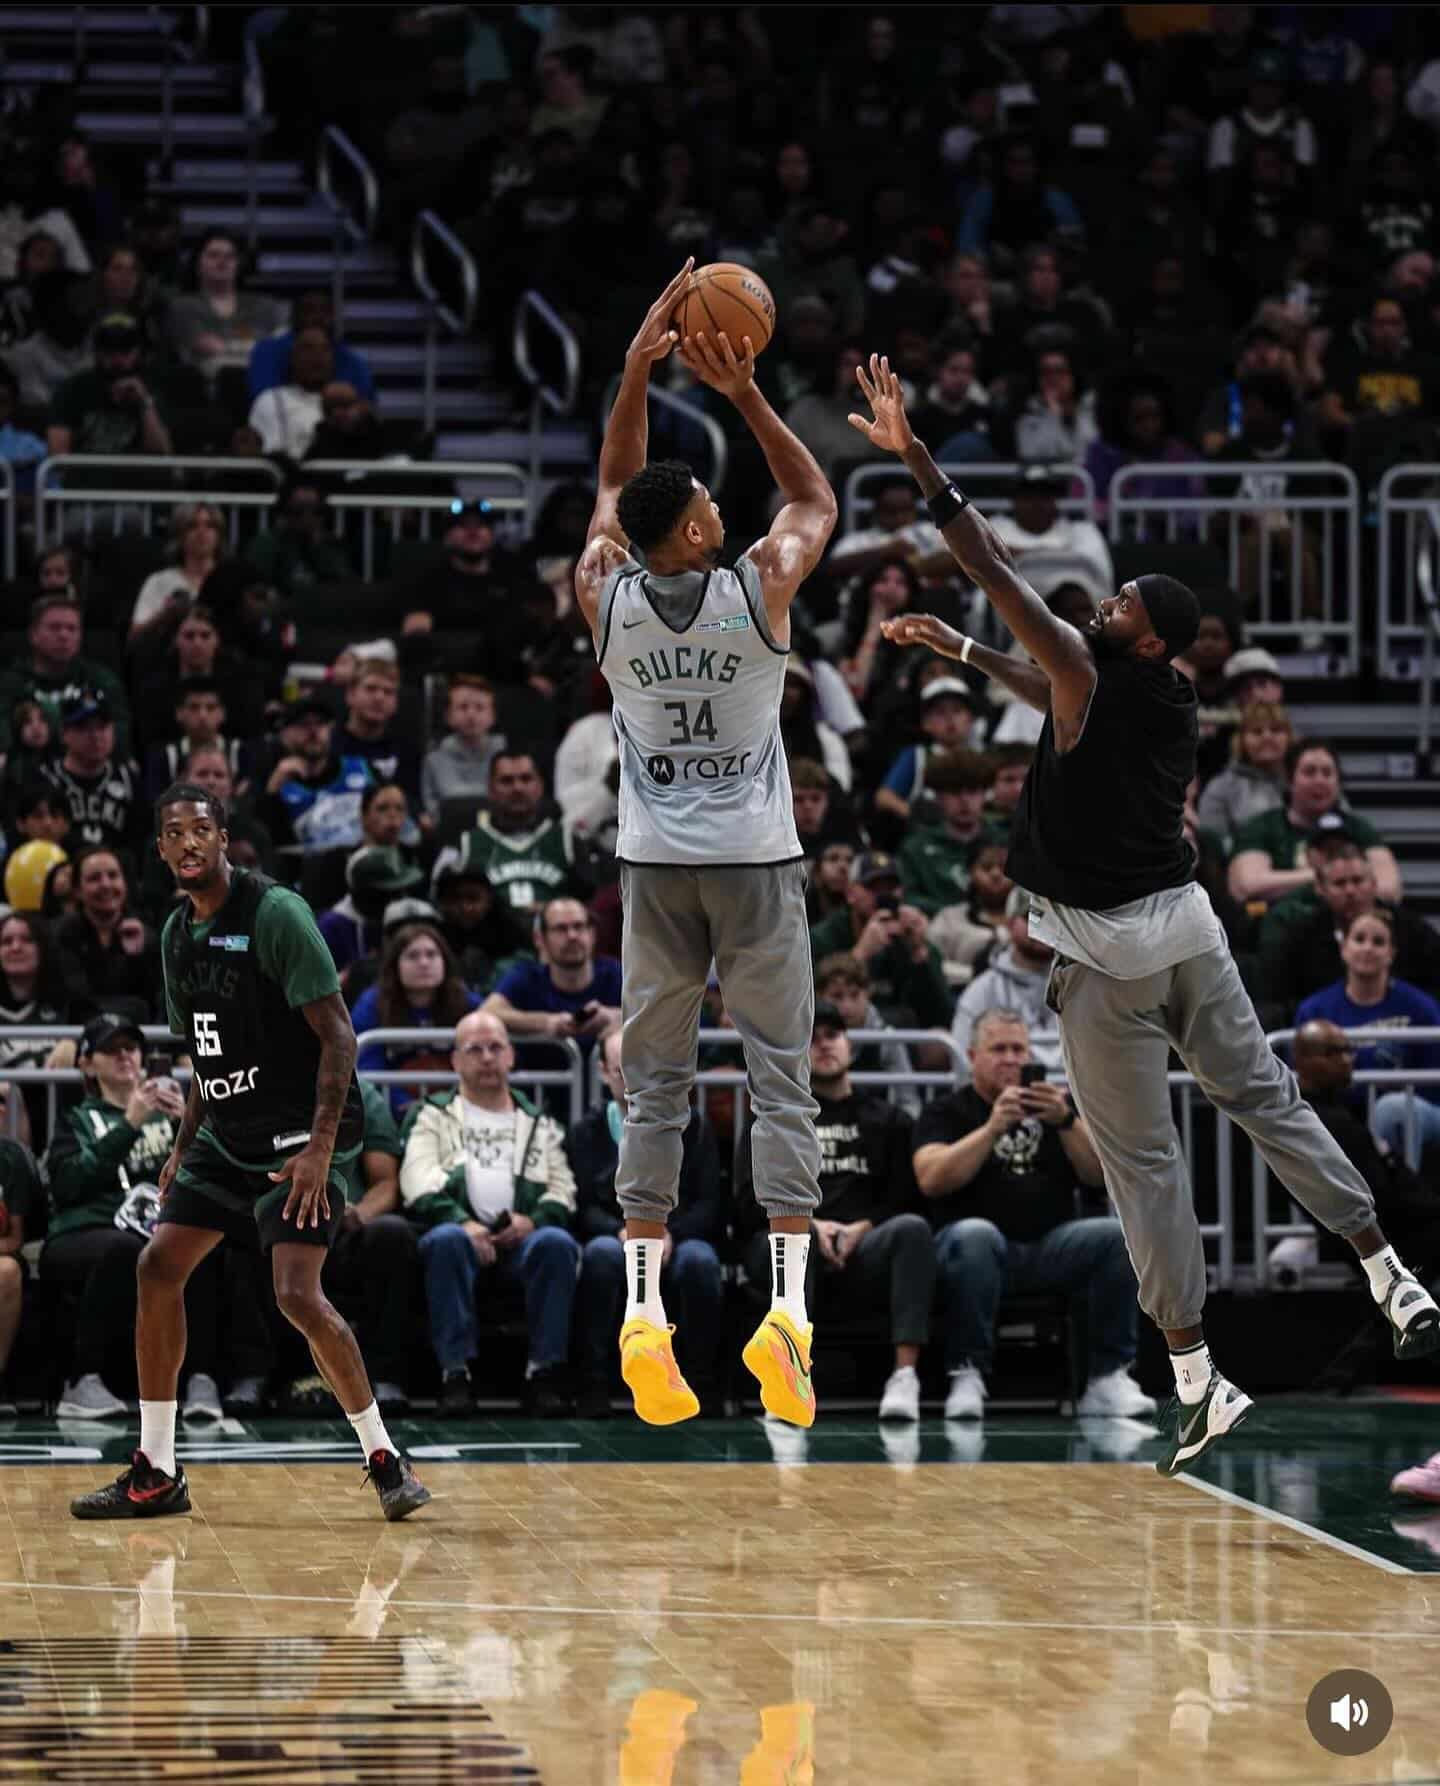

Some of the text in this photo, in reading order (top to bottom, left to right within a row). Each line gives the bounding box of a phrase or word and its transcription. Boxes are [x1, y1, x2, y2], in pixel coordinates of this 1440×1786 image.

[629, 647, 742, 688] BUCKS
[664, 699, 718, 745] 34
[684, 752, 751, 780] razr
[192, 1012, 223, 1057] 55
[203, 1065, 260, 1101] razr
